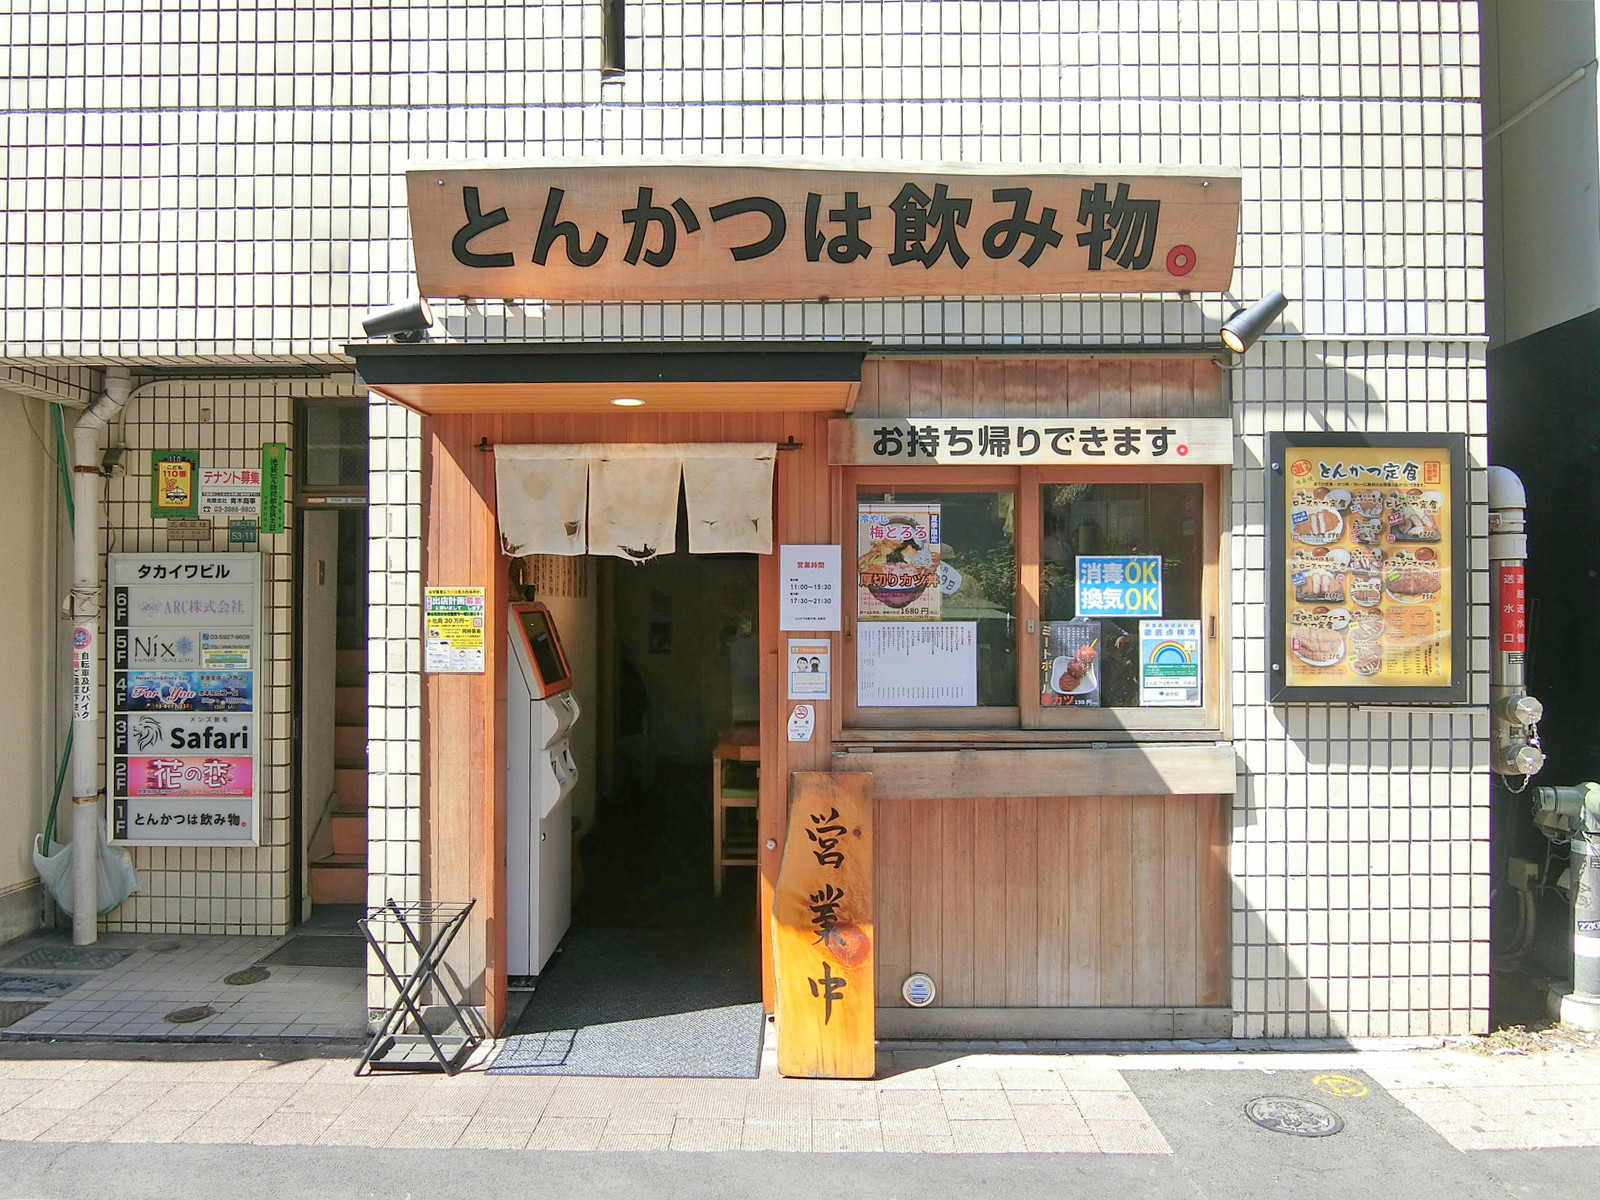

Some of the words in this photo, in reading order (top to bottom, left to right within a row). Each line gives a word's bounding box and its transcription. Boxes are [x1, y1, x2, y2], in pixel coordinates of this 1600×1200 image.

[451, 182, 1196, 277] とんかつは飲み物。
[873, 425, 1189, 458] お持ち帰りできます。
[204, 471, 260, 484] テナント募集
[1320, 463, 1419, 481] とんかつ定食
[1386, 500, 1438, 509] ヒレかつ定食
[860, 515, 890, 524] 冷やし
[870, 526, 927, 539] 梅とろろ
[138, 564, 230, 579] タカイワビル
[860, 573, 940, 588] 厚切りカツ丼
[1081, 561, 1158, 584] 消毒OK
[116, 593, 127, 621] 6F
[164, 599, 245, 614] ARC株式会社
[1081, 587, 1158, 610] 換気OK
[1503, 574, 1514, 643] 送水口
[116, 636, 127, 662] 5F
[134, 635, 176, 658] Nix
[1041, 626, 1053, 694] ミートボール
[81, 652, 90, 719] 自転車及びバイク
[116, 678, 127, 705] 4F
[132, 686, 159, 698] For
[166, 685, 196, 702] You
[116, 722, 126, 749] 3F
[170, 726, 248, 749] Safari
[116, 763, 126, 790] 2F
[153, 758, 229, 789] 花の恋
[116, 806, 126, 833] 1F
[135, 813, 247, 827] とんかつは飲み物。
[805, 807, 848, 1026] 営業中
[1578, 921, 1600, 930] 22K
